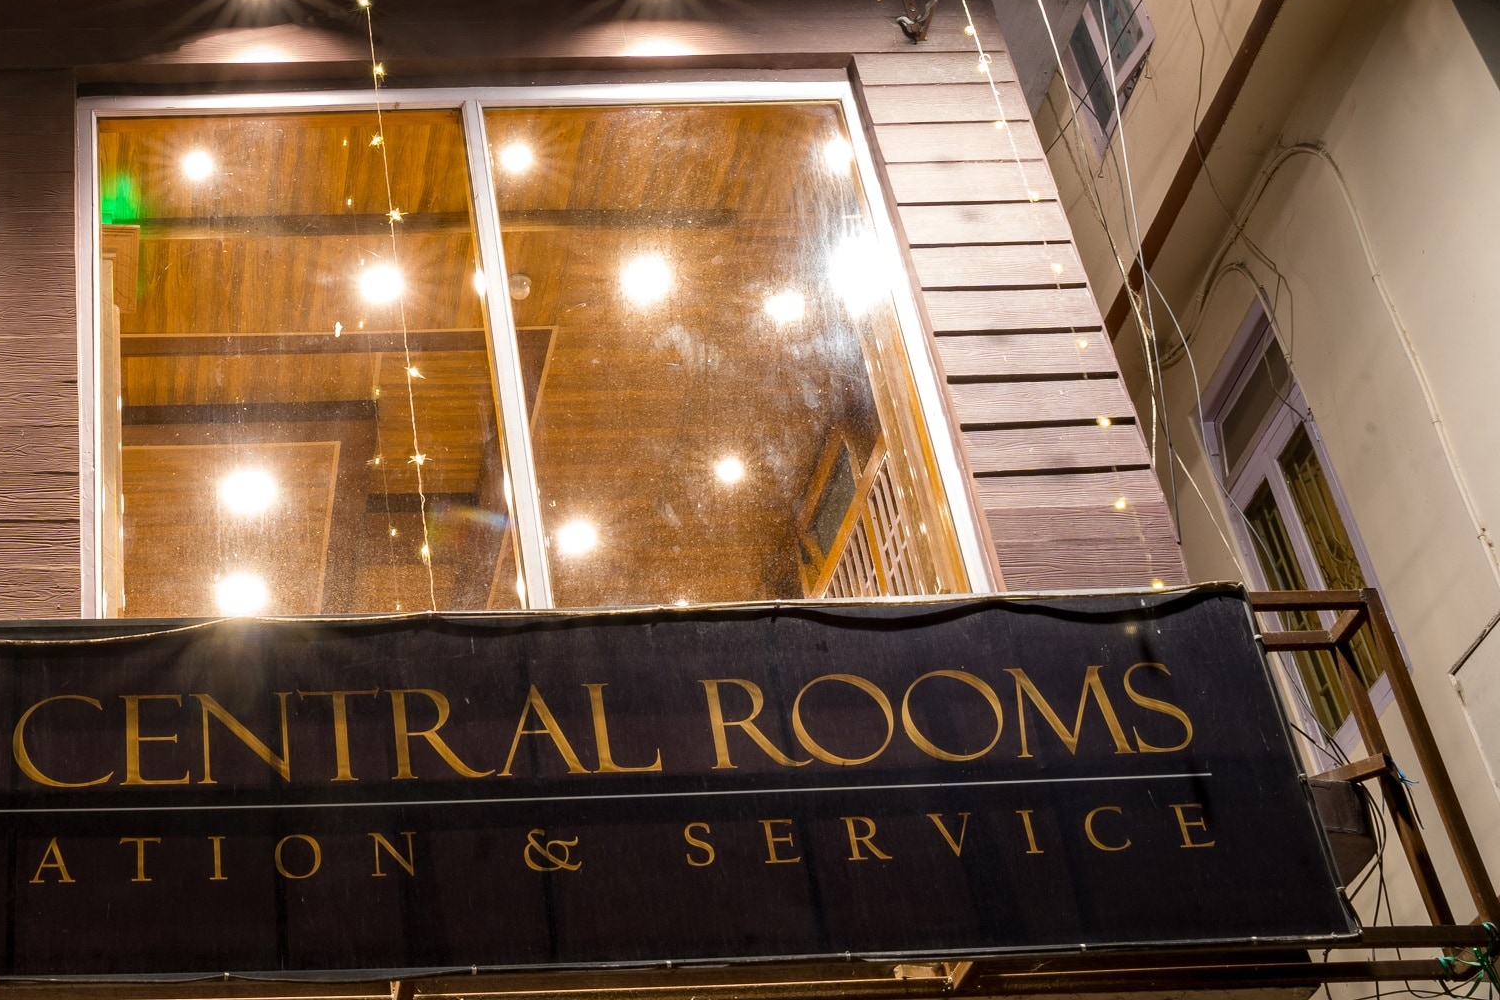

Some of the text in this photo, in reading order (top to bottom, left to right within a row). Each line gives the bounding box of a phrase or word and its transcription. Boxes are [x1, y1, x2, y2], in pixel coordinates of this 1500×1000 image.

[12, 684, 663, 788] CENTRAL
[701, 662, 1194, 770] ROOMS
[523, 829, 582, 872] &
[684, 802, 1216, 868] SERVICE
